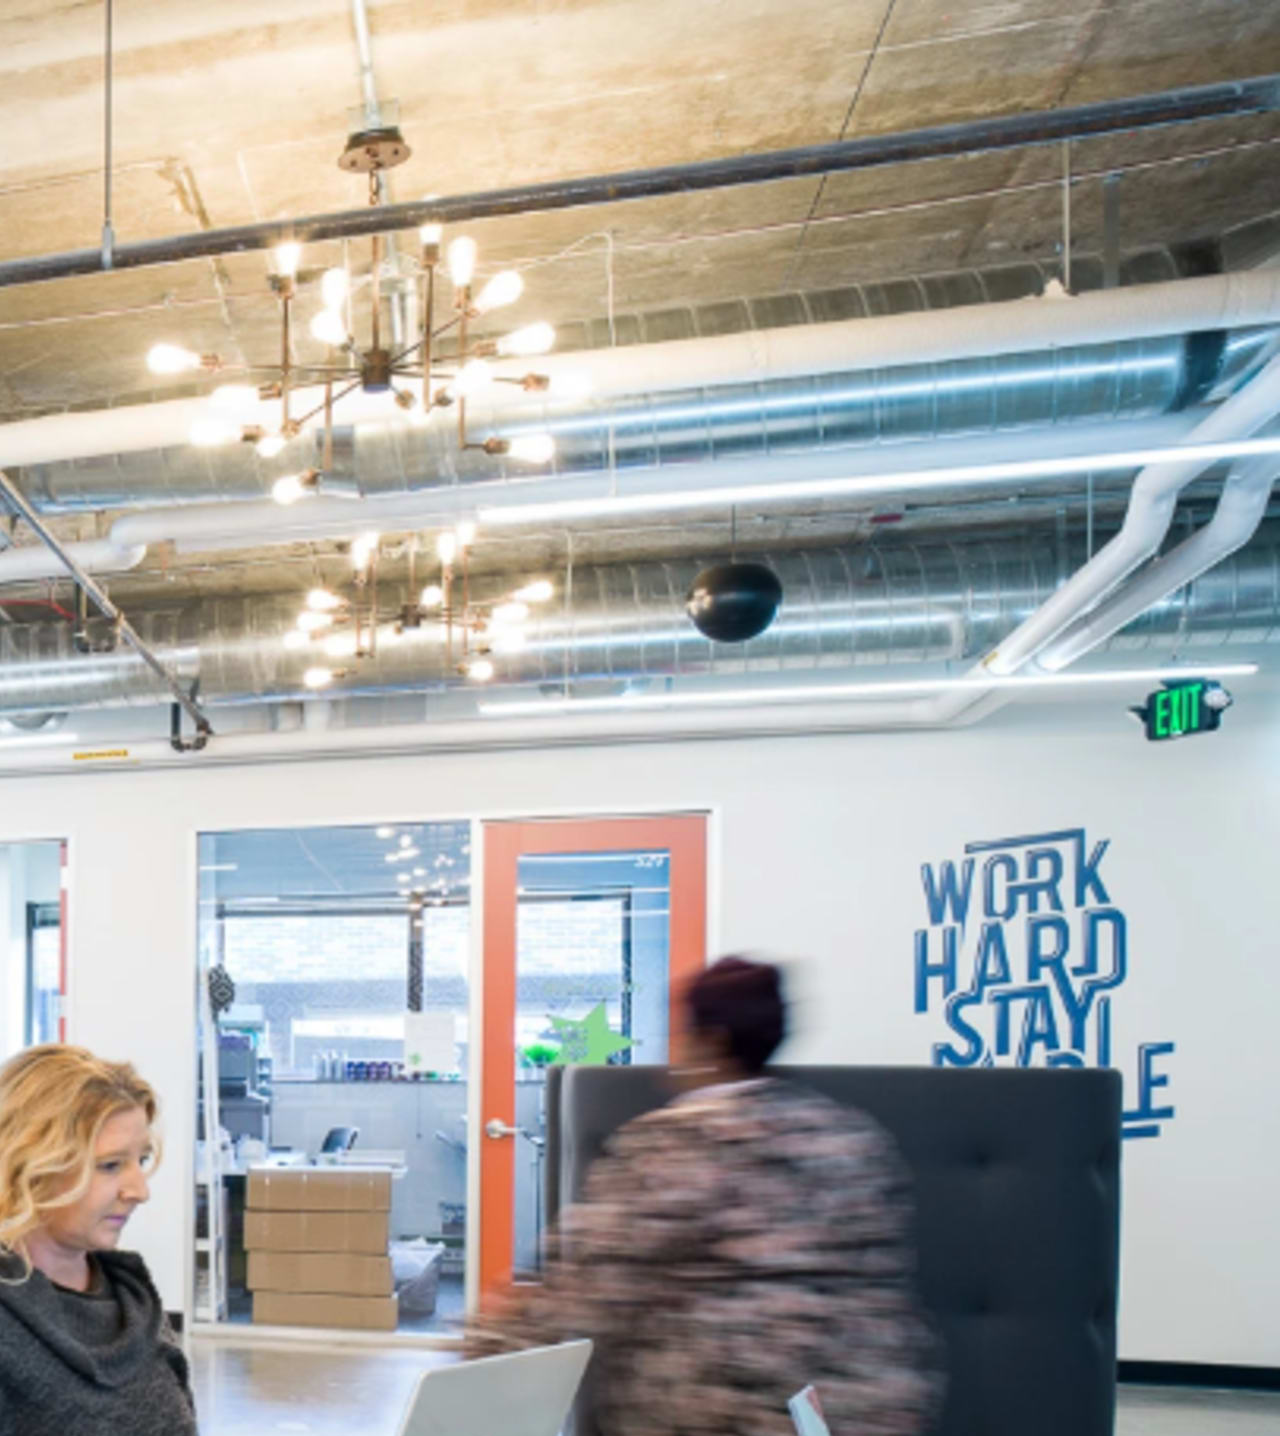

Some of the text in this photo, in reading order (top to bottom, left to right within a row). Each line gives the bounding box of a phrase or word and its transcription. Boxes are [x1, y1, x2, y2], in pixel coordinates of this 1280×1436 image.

[1156, 683, 1202, 736] EXIT
[920, 829, 1111, 930] WORK
[914, 907, 1128, 1014] HARD
[945, 983, 1097, 1067] STAY
